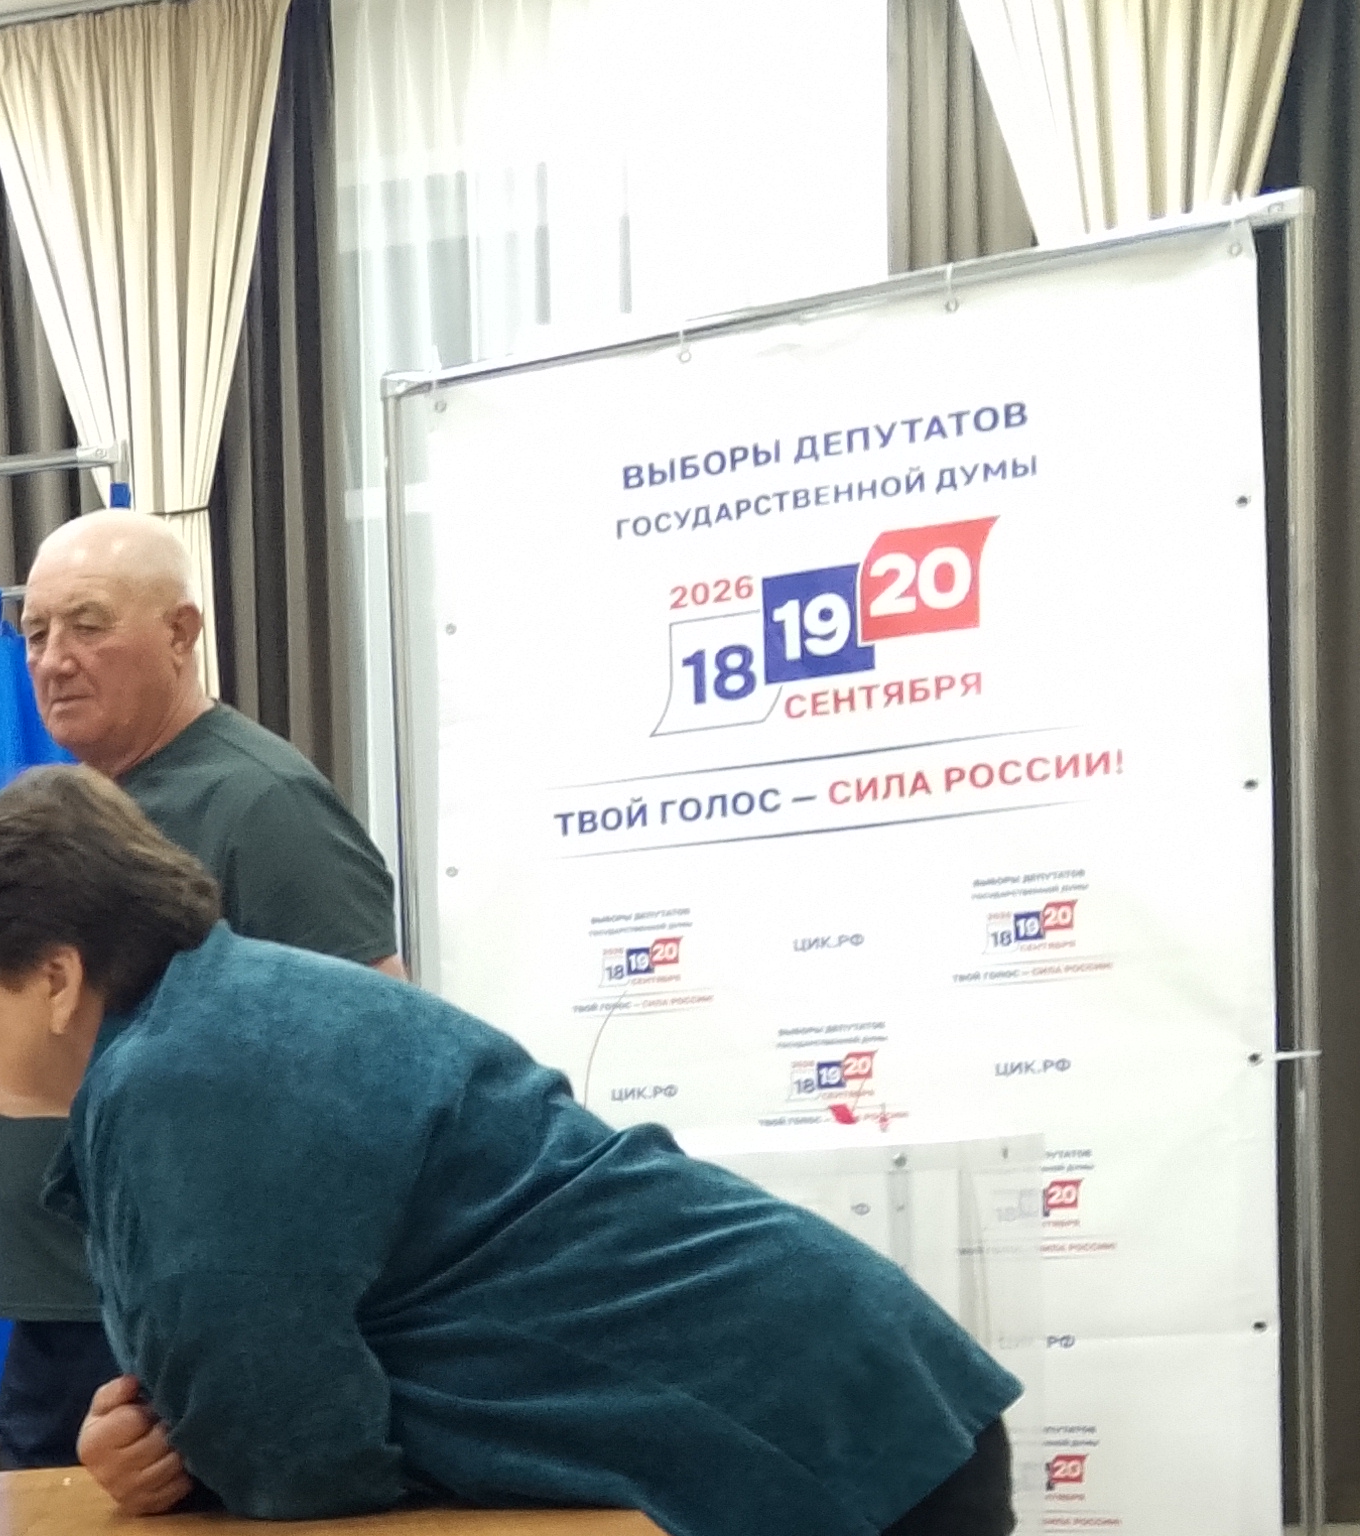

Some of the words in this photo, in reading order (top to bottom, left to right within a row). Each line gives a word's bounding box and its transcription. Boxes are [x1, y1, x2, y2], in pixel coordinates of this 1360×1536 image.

[622, 439, 781, 491] ВЫБОРЫ
[793, 401, 1028, 464] ДЕПУТАТОВ
[615, 466, 926, 540] ГОСУДАРСТВЕННОЙ
[935, 454, 1039, 495] ДУМЫ
[669, 574, 754, 610] 2026
[681, 643, 757, 704] 18
[772, 592, 851, 661] 19
[869, 547, 972, 614] 20
[783, 671, 983, 719] СЕНТЯБРЯ
[554, 799, 649, 837] ТВОЙ
[659, 788, 781, 827] ГОЛОС
[828, 761, 933, 806] СИЛА
[944, 749, 1124, 793] РОССИИ!
[792, 933, 865, 953] ЦИК.РФ
[991, 930, 1013, 948] 18
[1016, 917, 1040, 938] 19
[1043, 906, 1072, 927] 20
[605, 965, 625, 980] 18
[629, 952, 650, 971] 19
[651, 943, 678, 961] 20
[794, 1078, 815, 1094] 18
[818, 1065, 841, 1086] 19
[843, 1056, 871, 1076] 20
[994, 1057, 1071, 1078] ЦИК.РФ
[611, 1084, 678, 1102] ЦИК.РФ
[1047, 1184, 1077, 1205] 20
